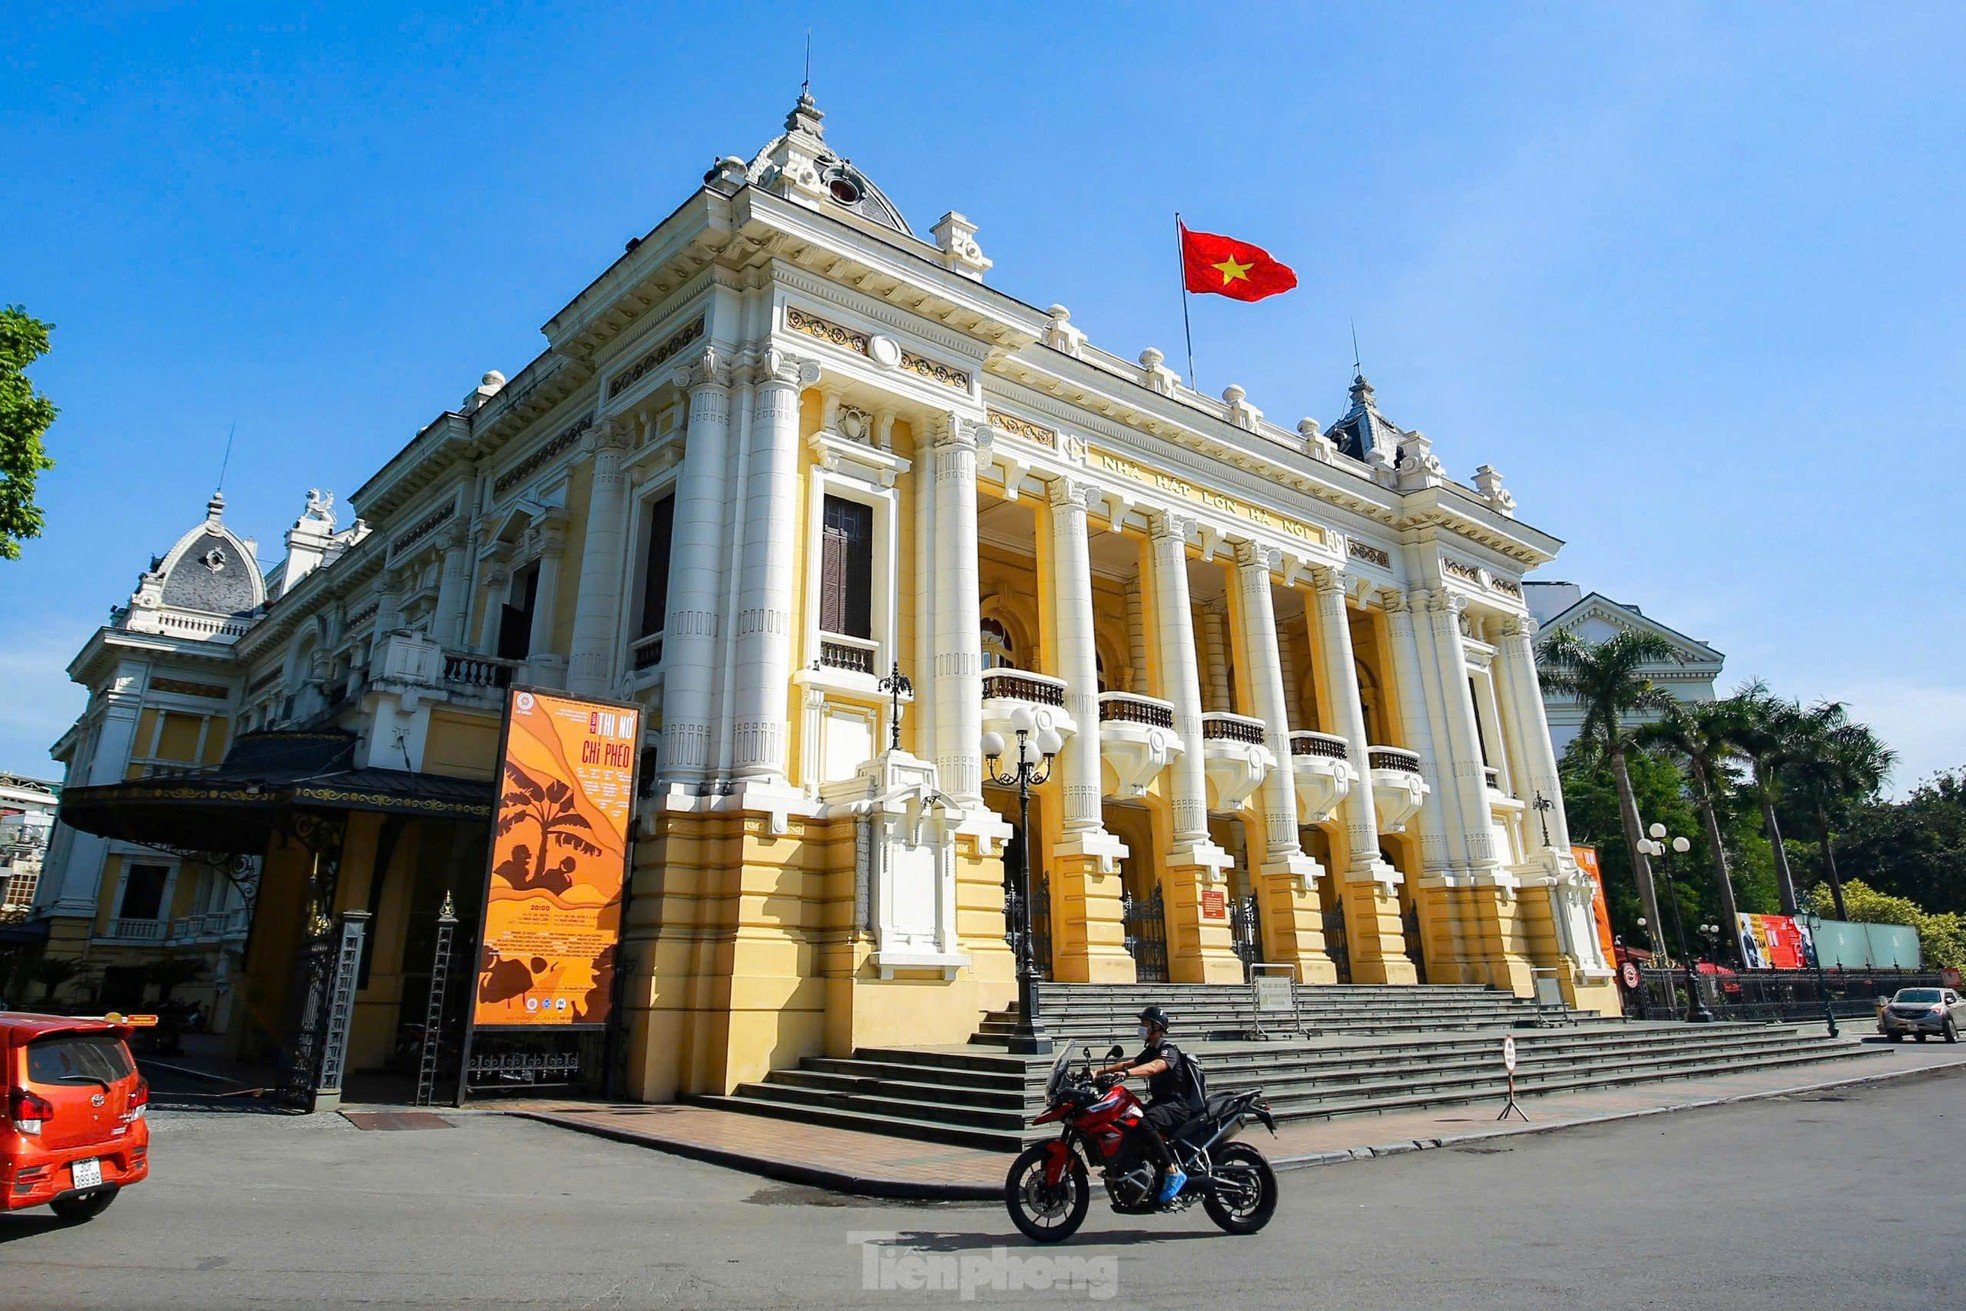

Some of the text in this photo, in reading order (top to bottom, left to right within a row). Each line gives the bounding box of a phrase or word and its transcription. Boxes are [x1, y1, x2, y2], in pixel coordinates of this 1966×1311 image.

[1102, 456, 1142, 480] NHÀ
[1155, 474, 1190, 497] HÁT
[1248, 509, 1271, 526] HÀ
